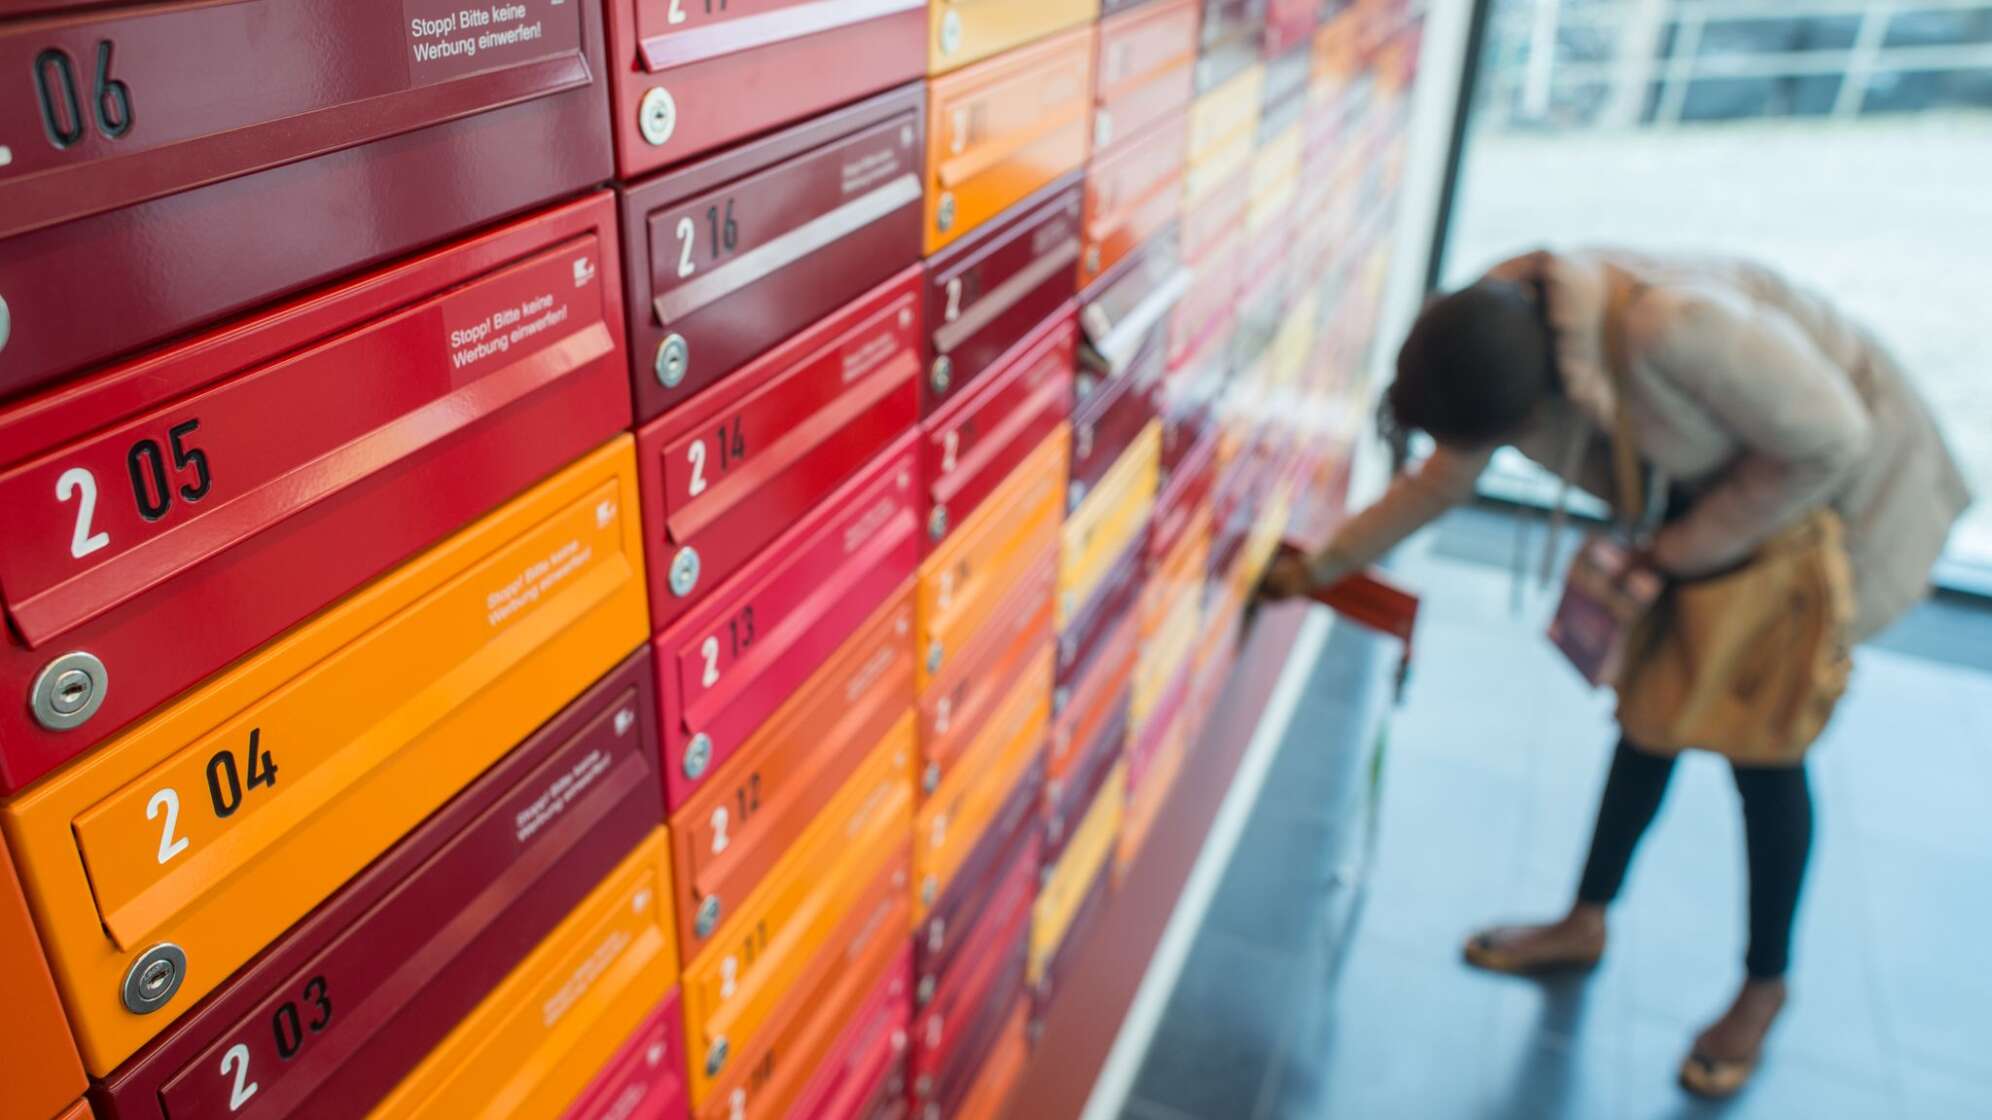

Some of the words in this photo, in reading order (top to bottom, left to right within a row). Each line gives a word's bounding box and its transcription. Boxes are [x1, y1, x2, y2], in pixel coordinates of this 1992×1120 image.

[411, 13, 457, 37] Stopp!
[459, 9, 490, 29] Bitte
[492, 3, 526, 23] keine
[413, 37, 476, 62] Werbung
[478, 22, 541, 49] einwerfen!
[35, 39, 135, 150] 06
[676, 215, 695, 278] 2
[706, 197, 738, 258] 16
[451, 317, 491, 348] Stopp!
[493, 307, 521, 331] Bitte
[522, 294, 553, 317] keine
[453, 334, 509, 368] Werbung
[510, 304, 568, 343] einwerfen!
[56, 467, 110, 559] 2
[127, 418, 212, 523] 05
[687, 439, 707, 497] 2
[717, 413, 745, 473] 14
[701, 635, 720, 688] 2
[729, 604, 755, 658] 13
[146, 788, 189, 864] 2
[206, 727, 278, 819] 04
[711, 805, 730, 854] 2
[220, 1043, 258, 1112] 2
[273, 975, 332, 1061] 03
